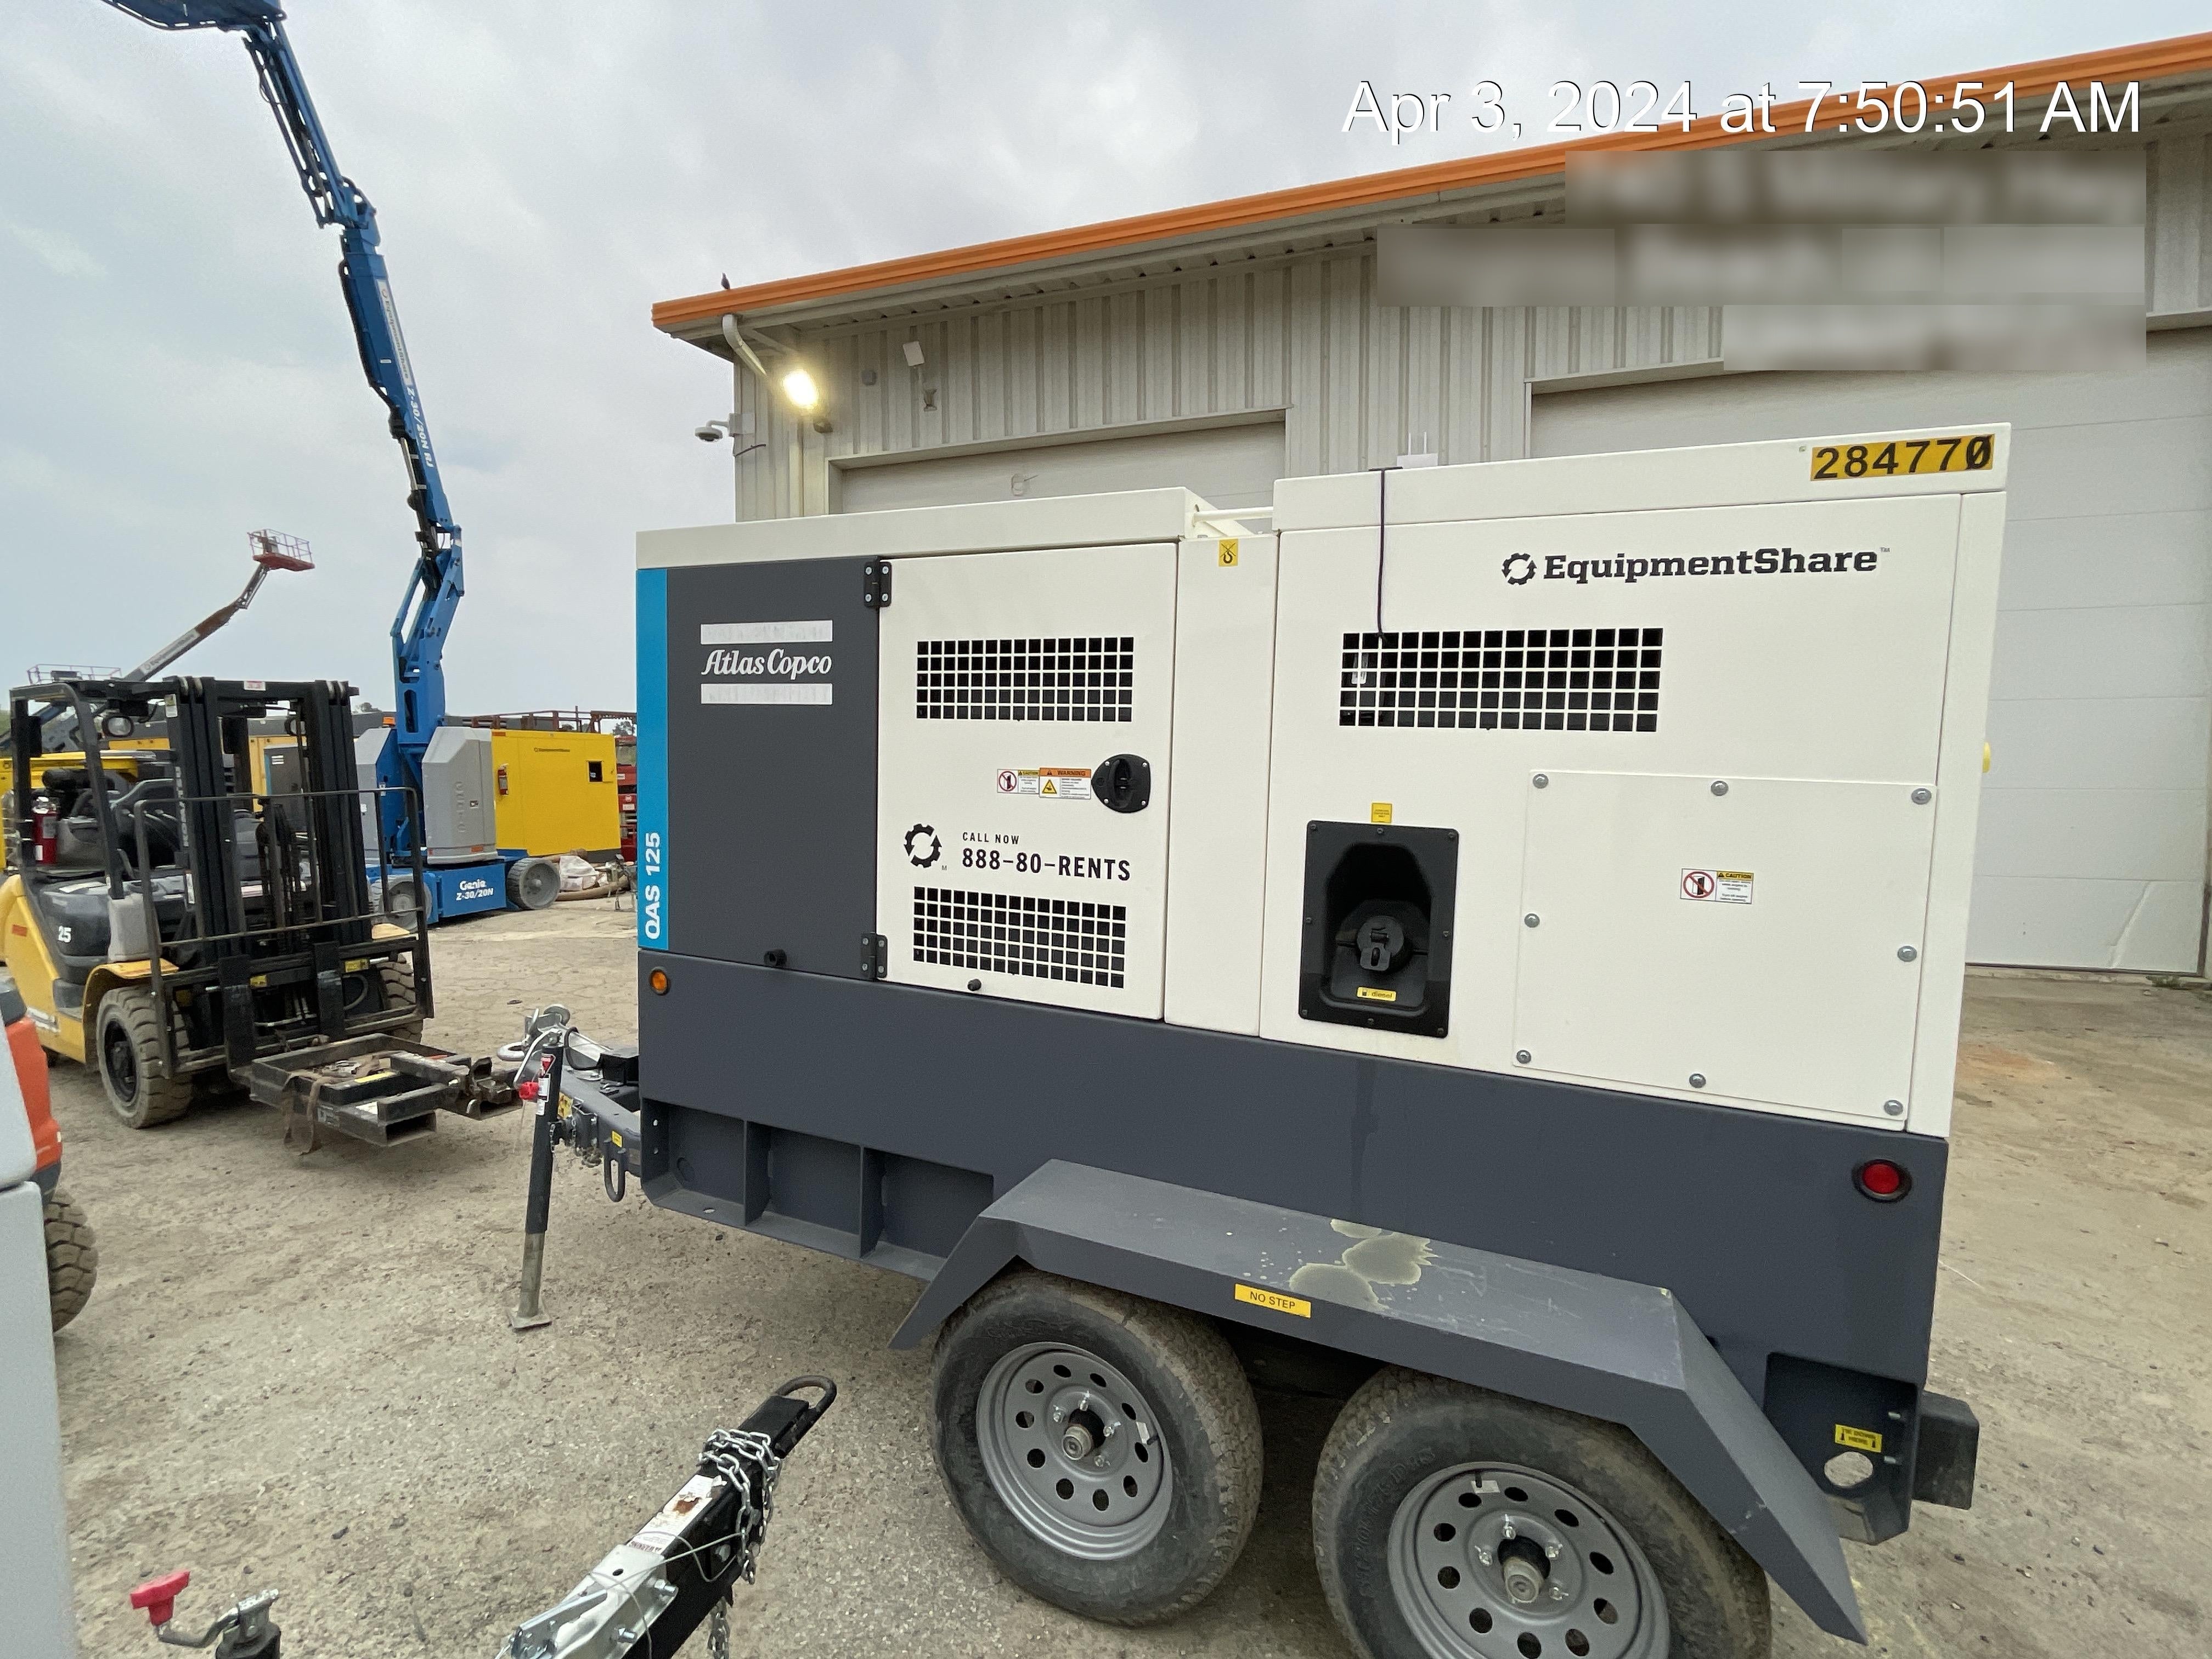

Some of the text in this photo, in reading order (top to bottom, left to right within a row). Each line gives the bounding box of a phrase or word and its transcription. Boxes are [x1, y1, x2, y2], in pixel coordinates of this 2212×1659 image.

[407, 387, 430, 449] Z-30/20N
[1813, 435, 1994, 479] 284770
[1543, 548, 1878, 584] EquipmentShare
[963, 832, 1020, 845] CALL NOW
[645, 832, 661, 876] 125
[962, 848, 1131, 881] 888-80-RENTS
[455, 888, 494, 901] Z-30/20N
[459, 878, 487, 891] Genie
[58, 926, 71, 943] 25
[1250, 1291, 1296, 1310] NO STEP
